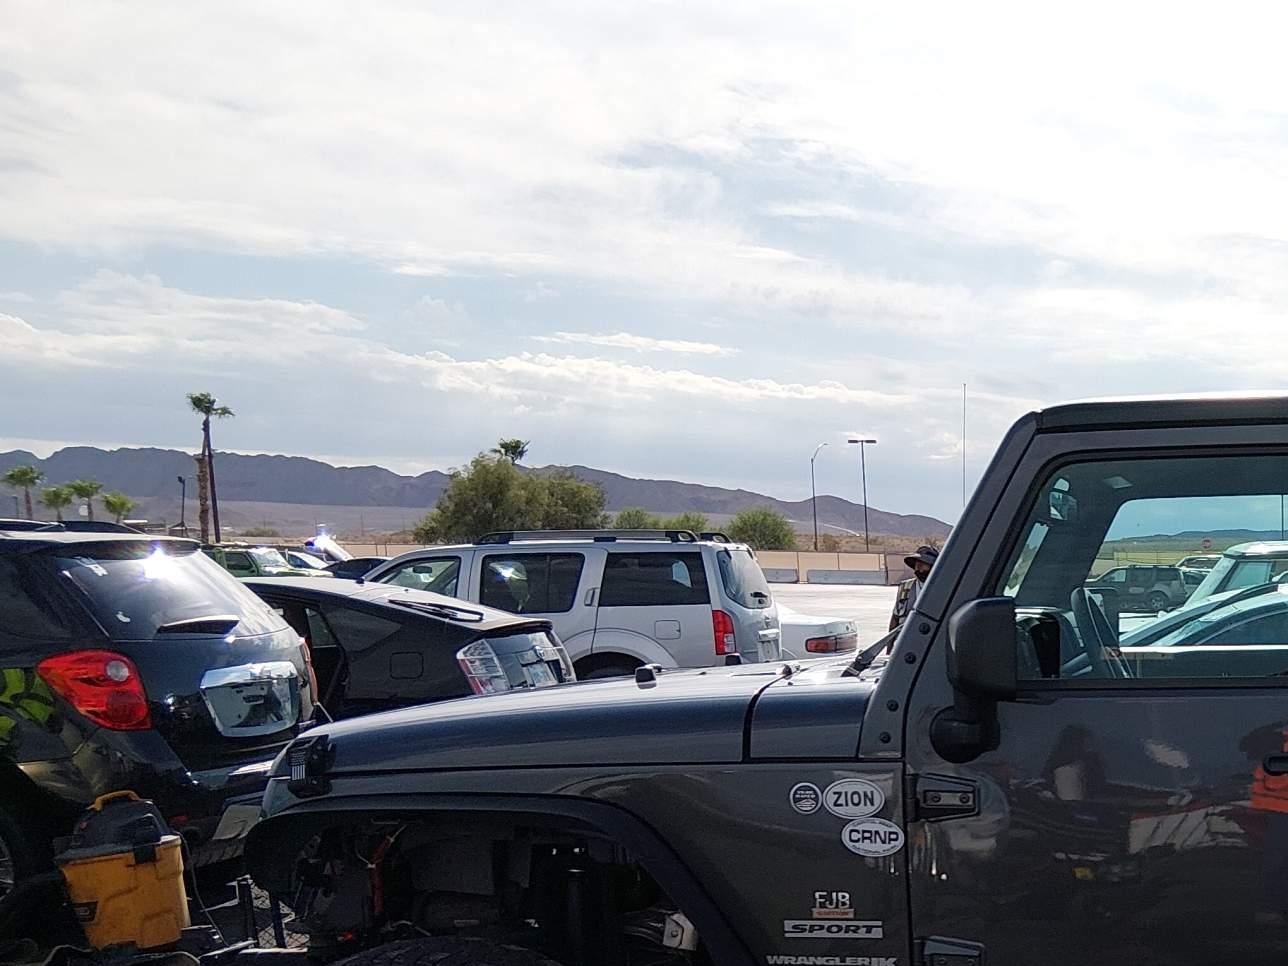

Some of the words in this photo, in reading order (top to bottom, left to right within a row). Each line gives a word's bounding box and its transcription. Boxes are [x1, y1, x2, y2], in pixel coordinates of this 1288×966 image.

[833, 791, 875, 807] ZION
[849, 829, 899, 844] CRNP
[815, 892, 850, 909] FJB
[785, 924, 882, 934] SPORT
